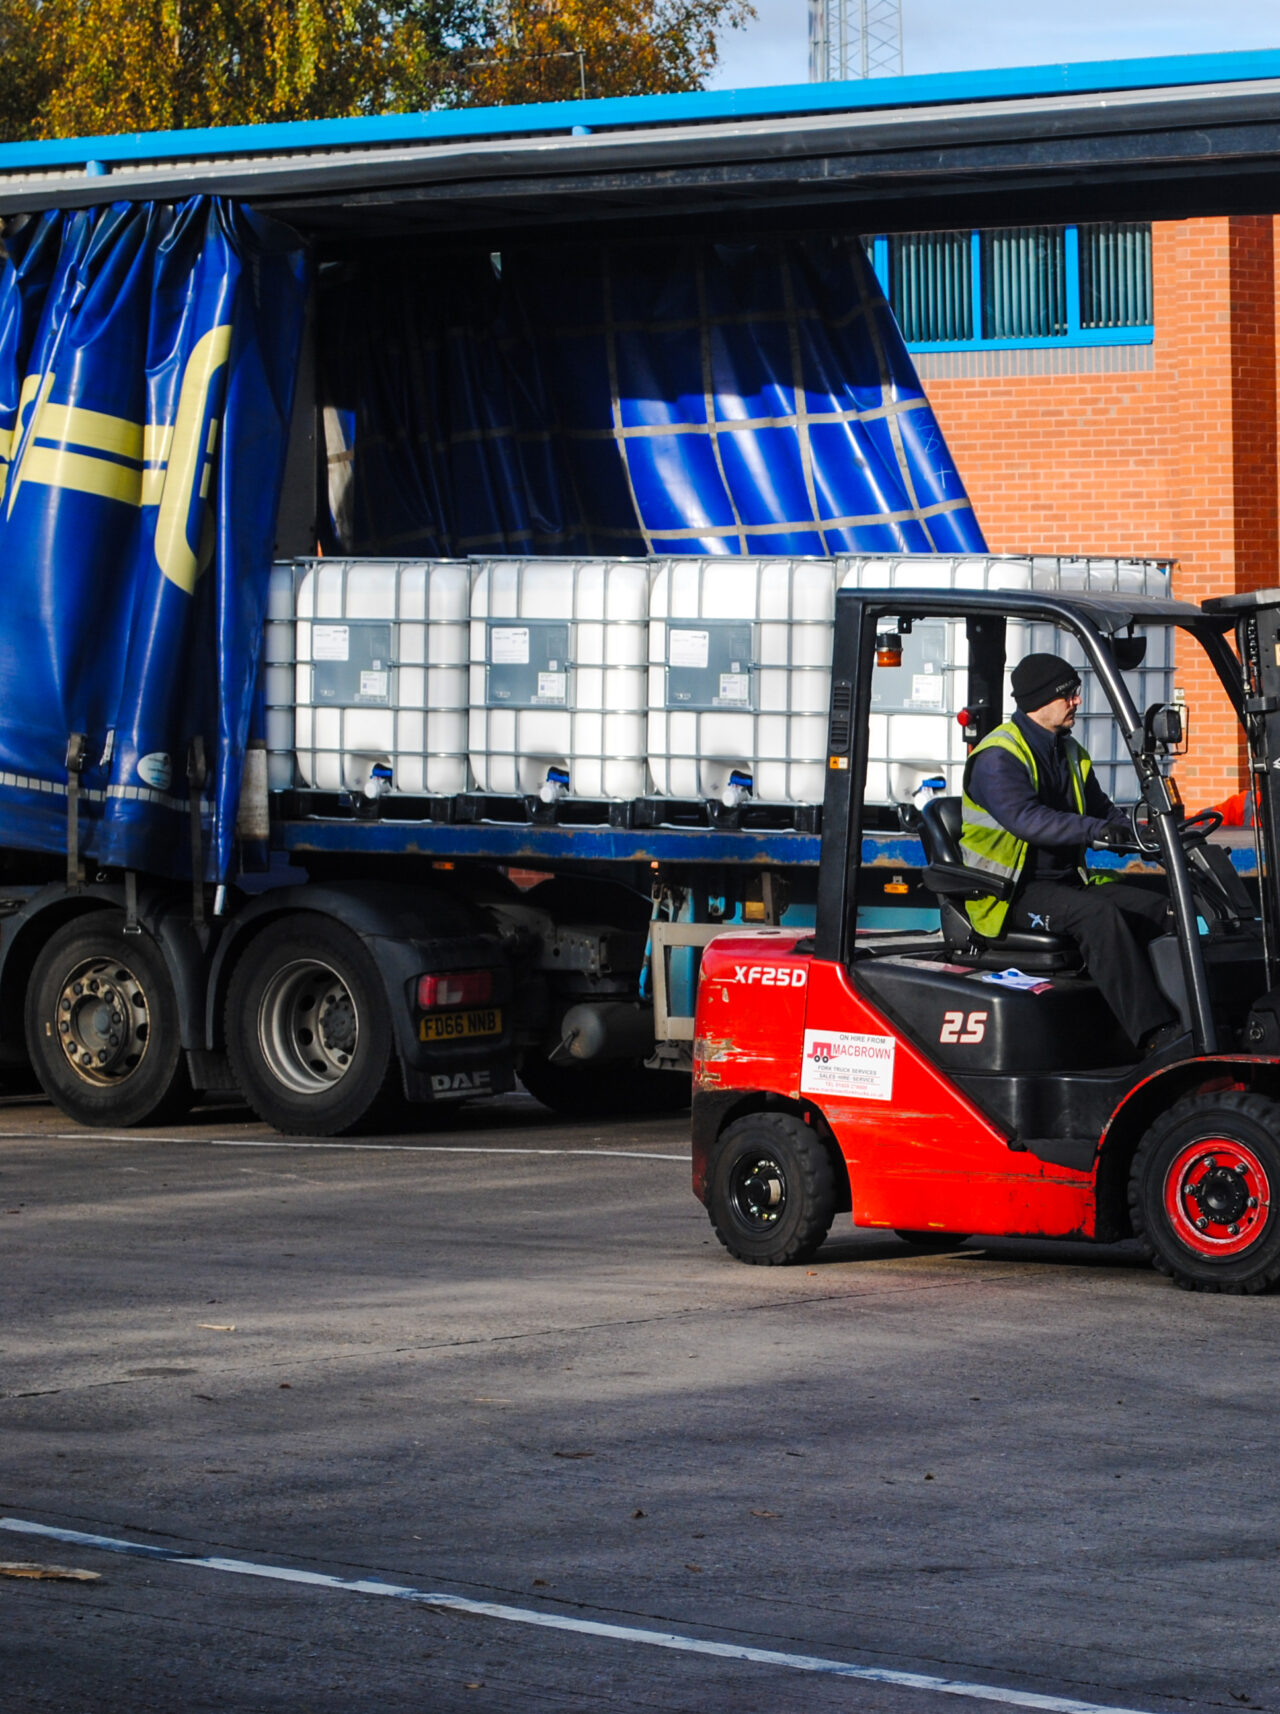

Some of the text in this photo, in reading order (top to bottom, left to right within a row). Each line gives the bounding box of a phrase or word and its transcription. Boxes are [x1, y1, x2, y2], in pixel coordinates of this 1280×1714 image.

[734, 965, 807, 987] XF25D
[424, 1012, 496, 1038] FD66 NNB
[939, 1011, 988, 1043] 25
[850, 1035, 865, 1043] HIRE
[867, 1036, 886, 1044] FROM
[832, 1043, 891, 1060] MACBROWN
[431, 1070, 490, 1091] DAF
